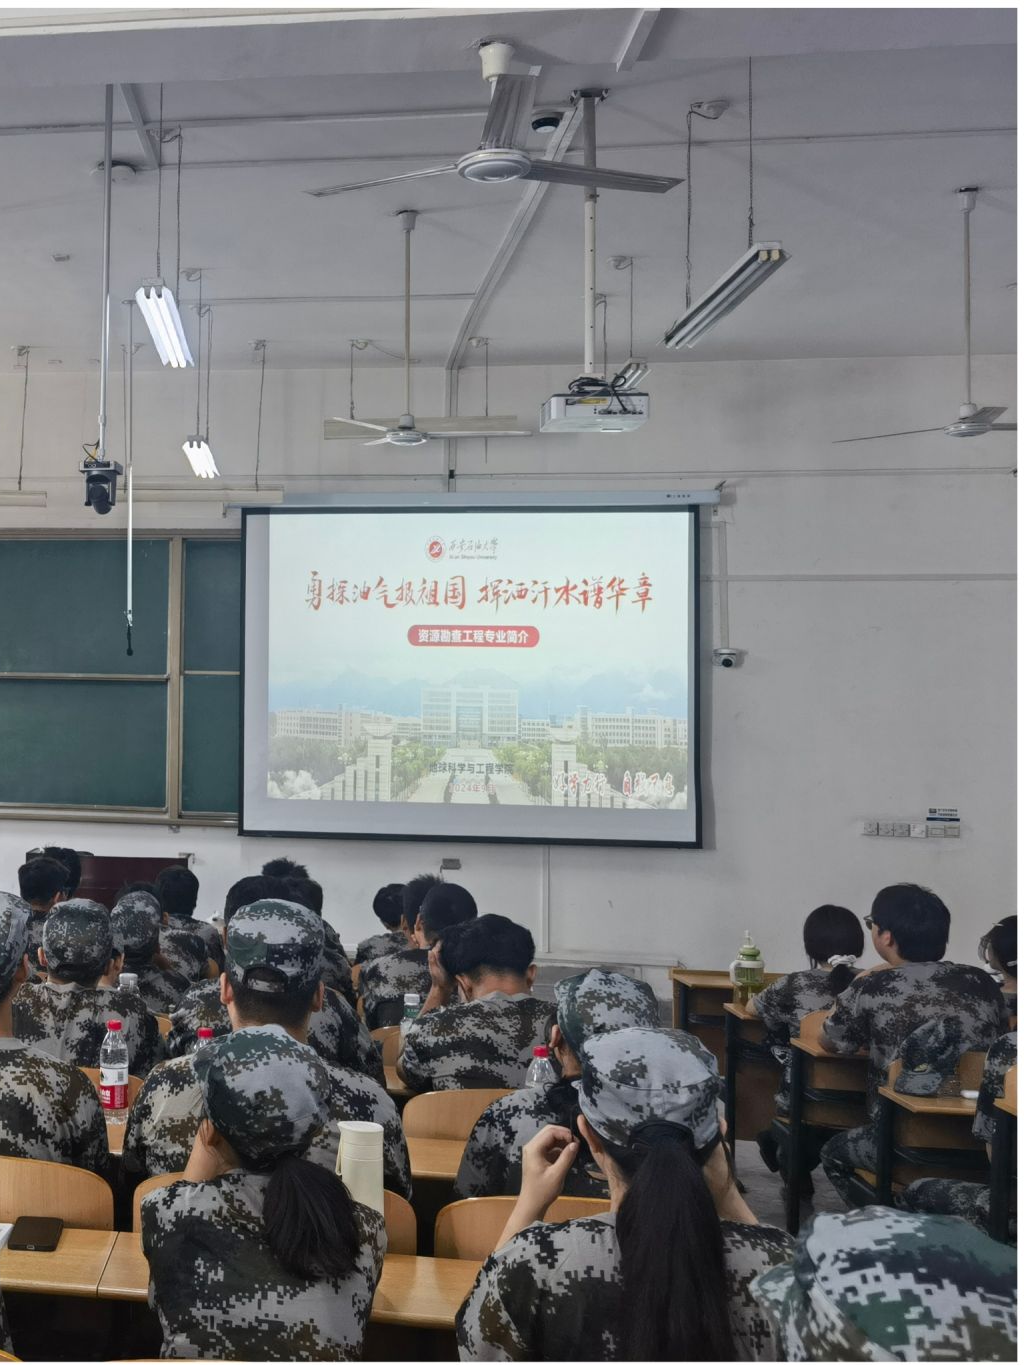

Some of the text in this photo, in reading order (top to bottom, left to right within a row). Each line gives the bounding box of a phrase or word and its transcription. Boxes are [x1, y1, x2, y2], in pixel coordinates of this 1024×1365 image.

[418, 628, 529, 644] 资源勘查工程专业简介
[429, 762, 514, 775] 地球科学与工程学院
